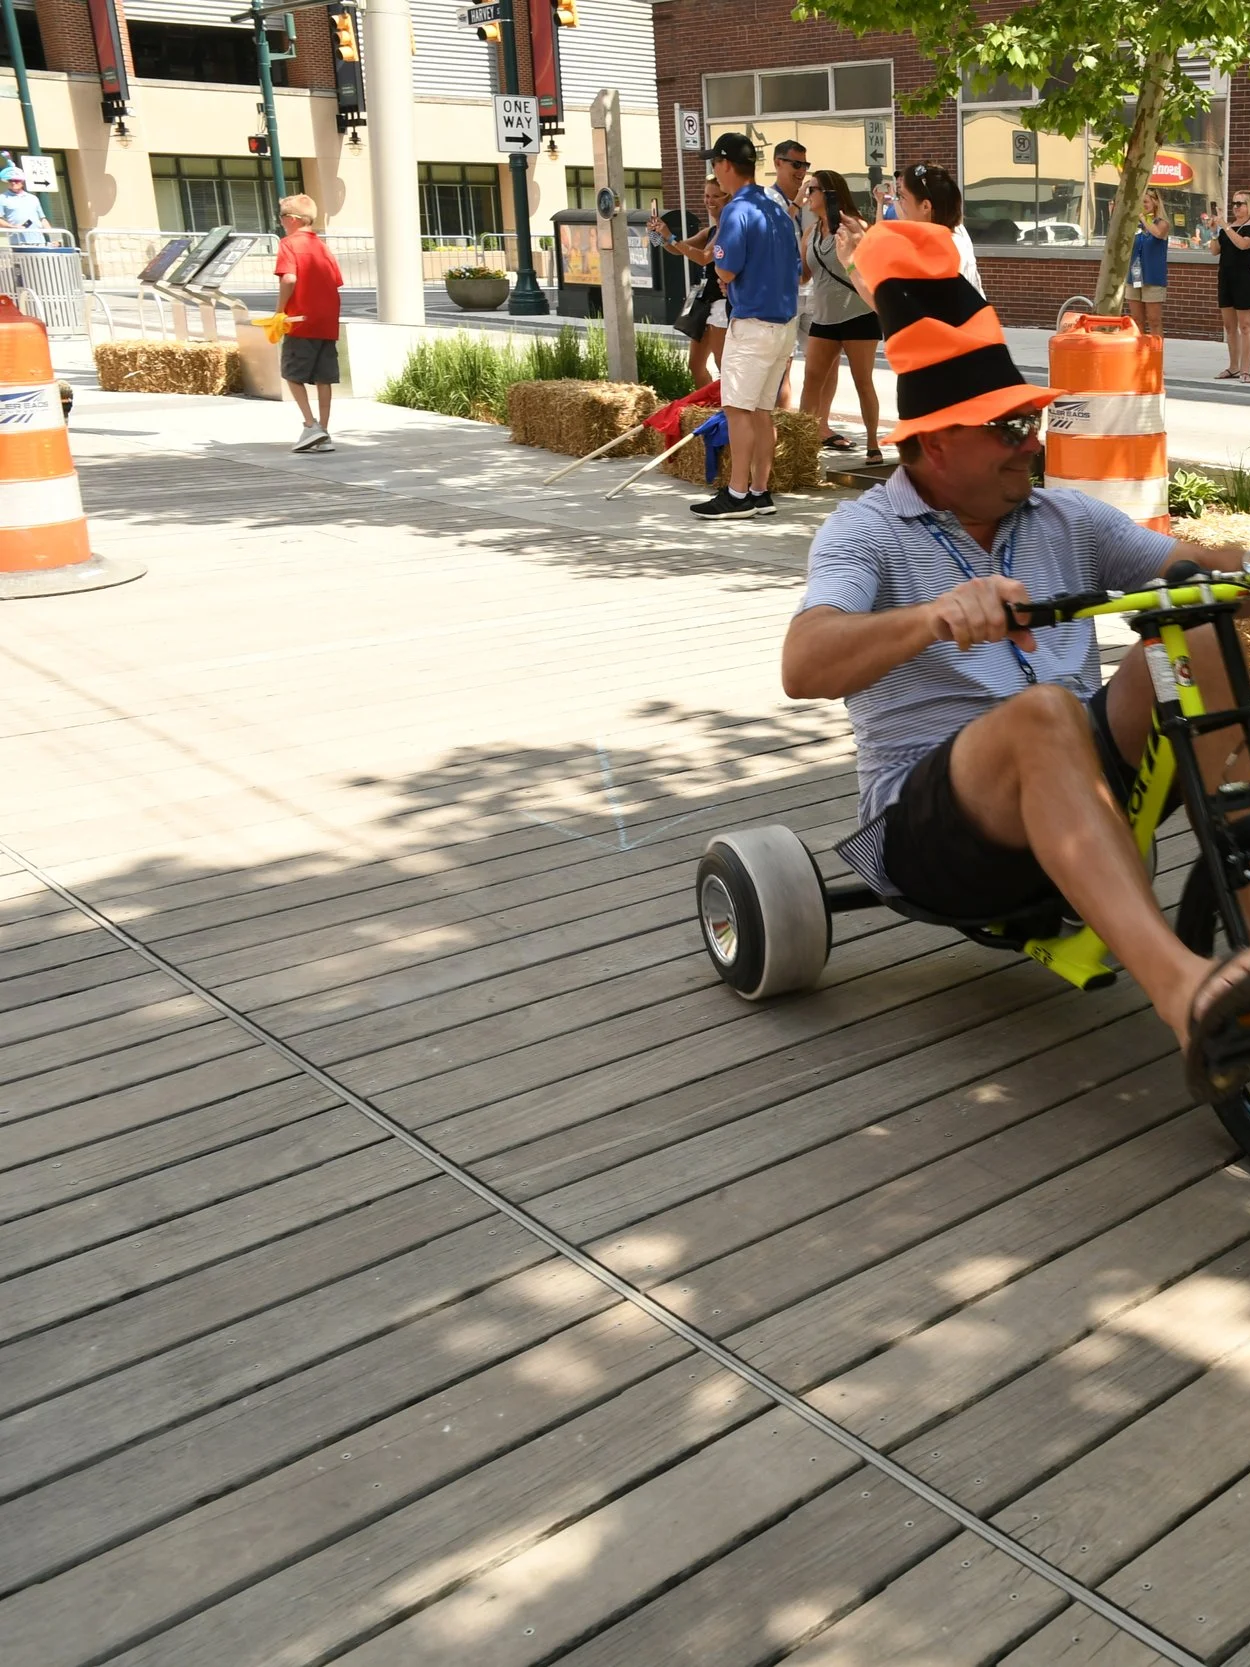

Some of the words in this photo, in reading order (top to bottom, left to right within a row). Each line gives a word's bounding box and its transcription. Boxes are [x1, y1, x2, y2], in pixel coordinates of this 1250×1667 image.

[470, 5, 494, 23] HARVEY
[503, 100, 531, 114] ONE
[503, 116, 532, 129] WAY
[1066, 410, 1090, 418] EADS
